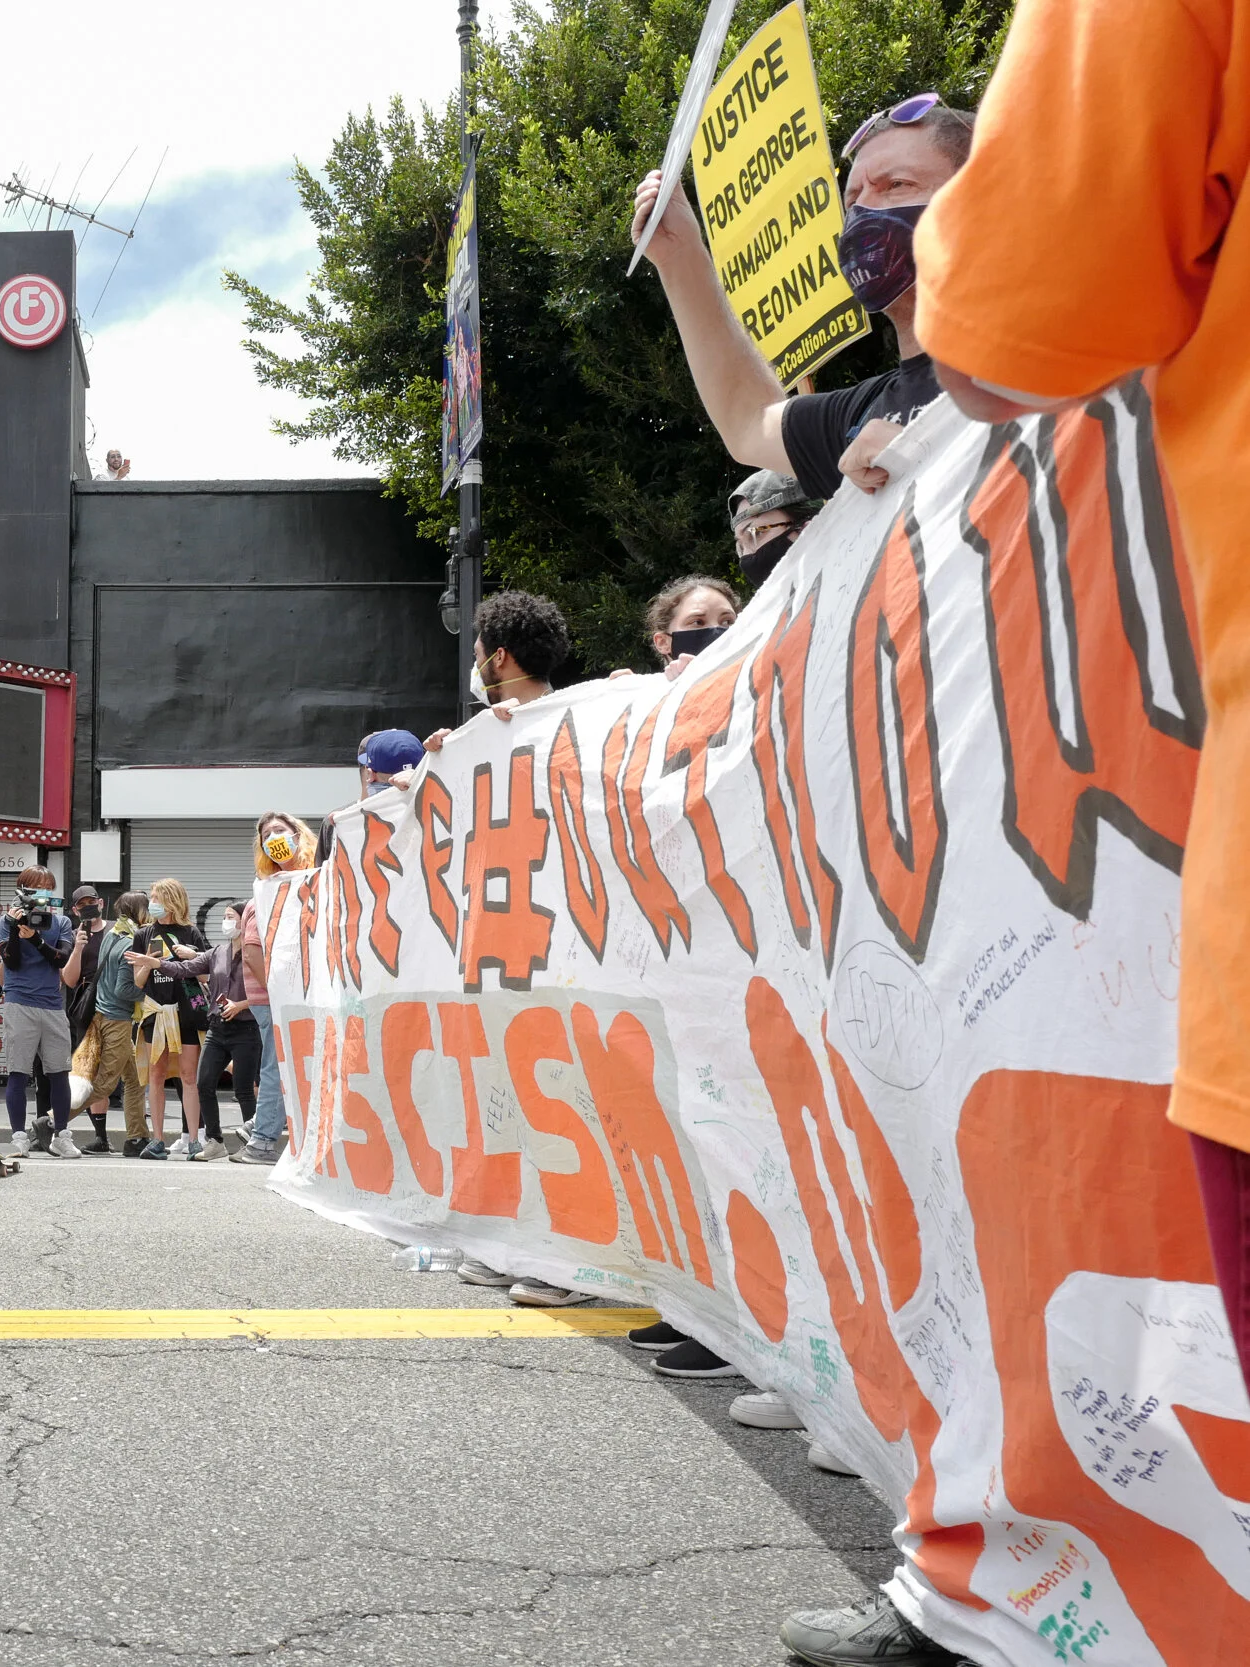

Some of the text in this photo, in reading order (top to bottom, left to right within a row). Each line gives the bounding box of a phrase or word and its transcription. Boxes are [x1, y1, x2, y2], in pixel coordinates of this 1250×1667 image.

[702, 37, 790, 167] JUSTICE
[705, 107, 818, 240] FOR GEORGE,
[720, 175, 830, 296] AHMAUD, AND
[741, 243, 838, 342] REONNA
[774, 307, 859, 383] erCoaltion.org
[997, 927, 1019, 954] USA
[486, 1085, 506, 1135] FEEL
[1007, 1540, 1090, 1617] breathing
